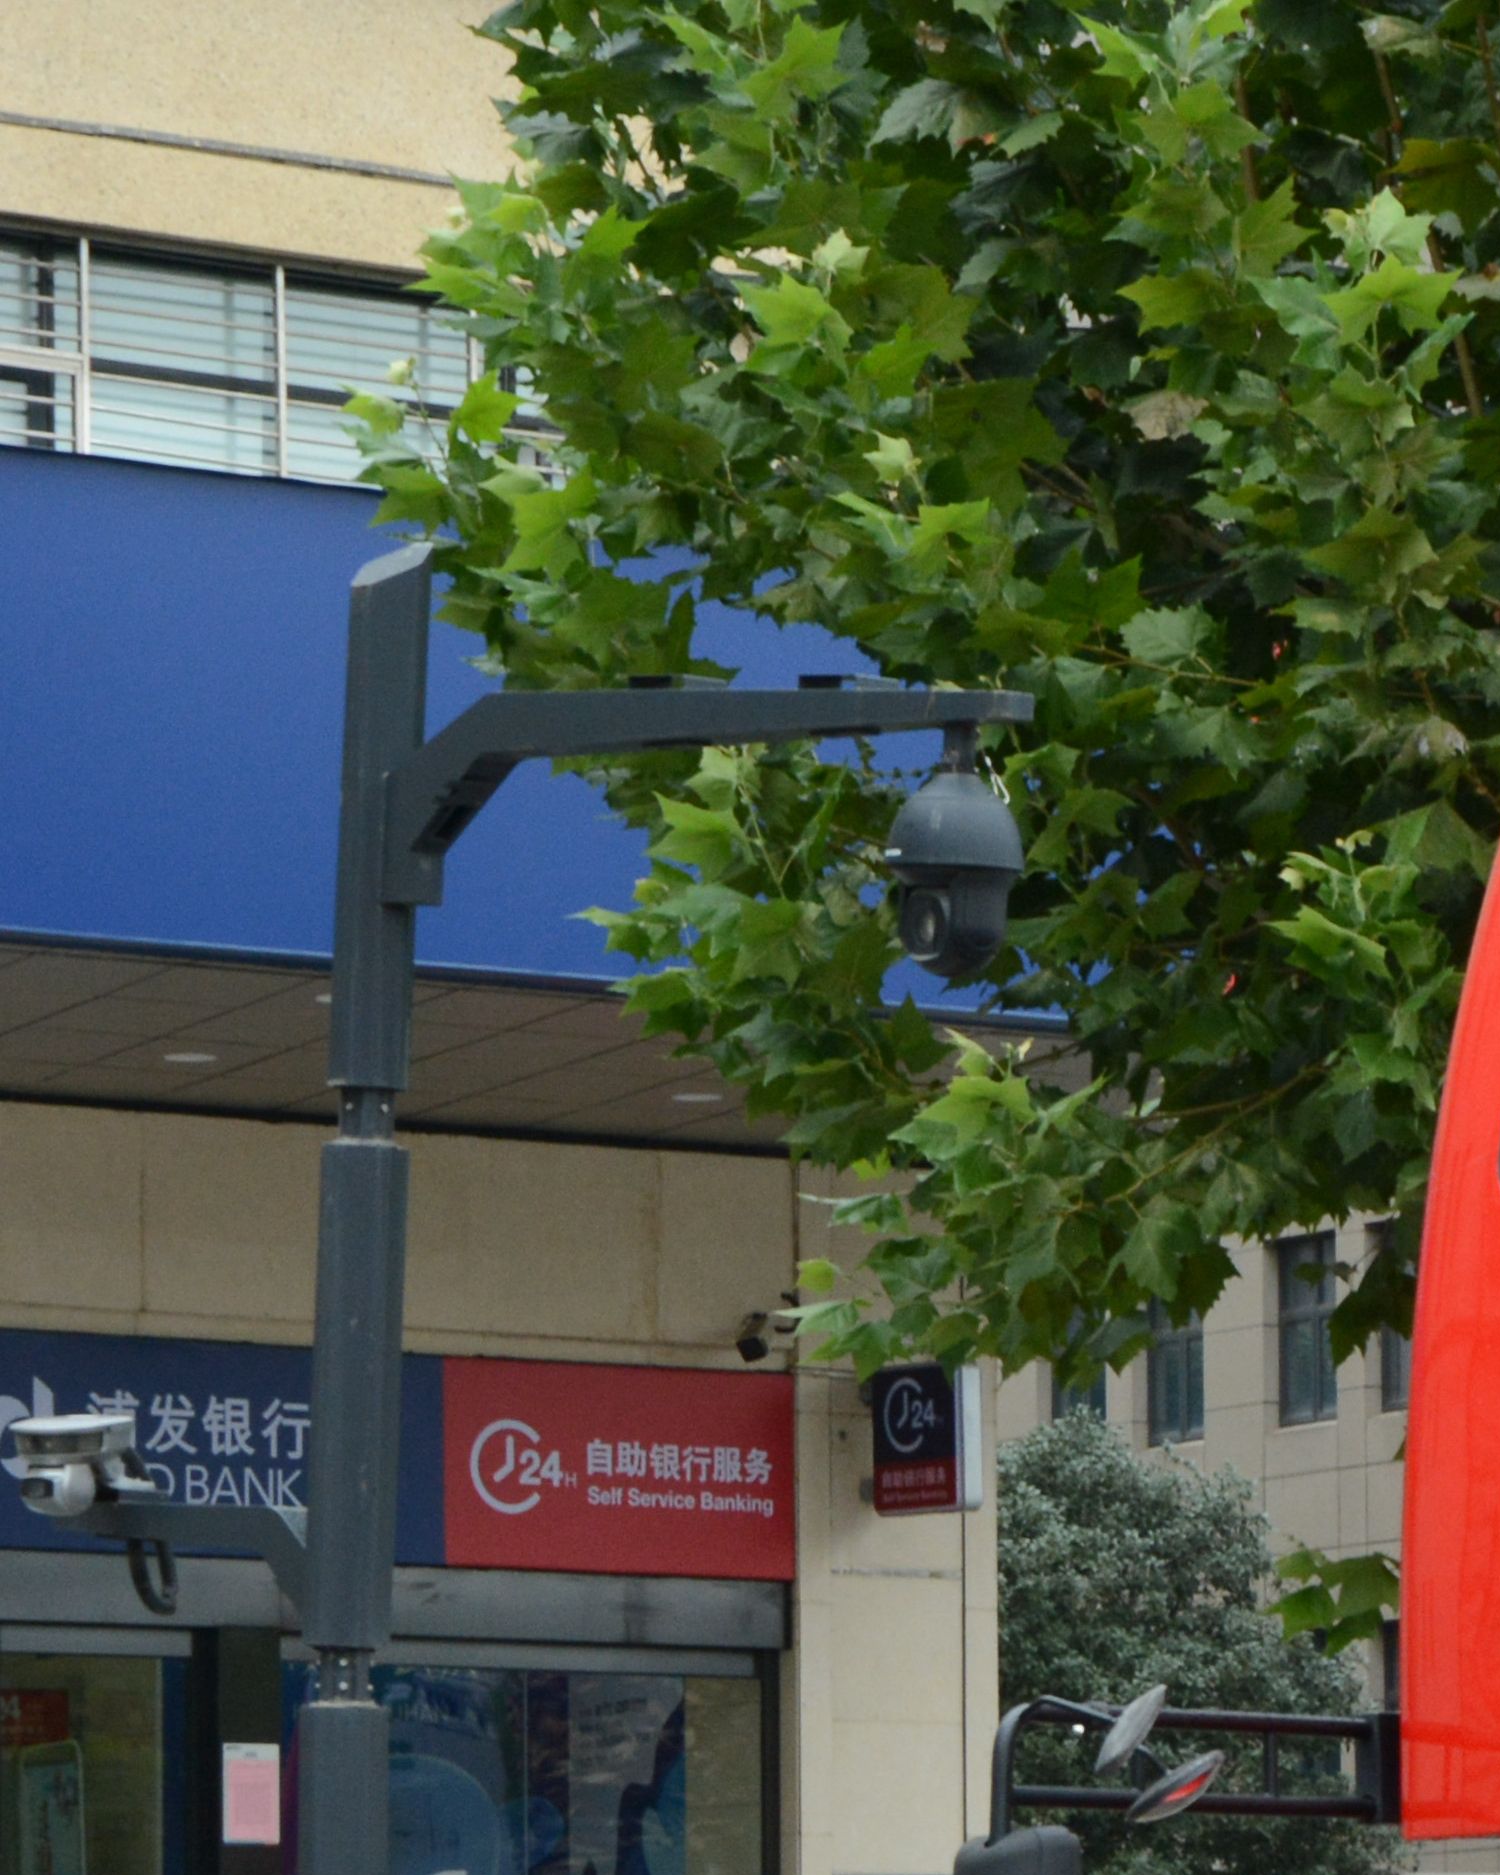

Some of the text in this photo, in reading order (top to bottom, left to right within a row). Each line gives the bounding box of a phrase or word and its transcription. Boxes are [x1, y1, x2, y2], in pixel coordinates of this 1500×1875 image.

[586, 1438, 772, 1484] 自助银行服务
[185, 1464, 303, 1506] BANK
[587, 1486, 774, 1517] Self Service Banking
